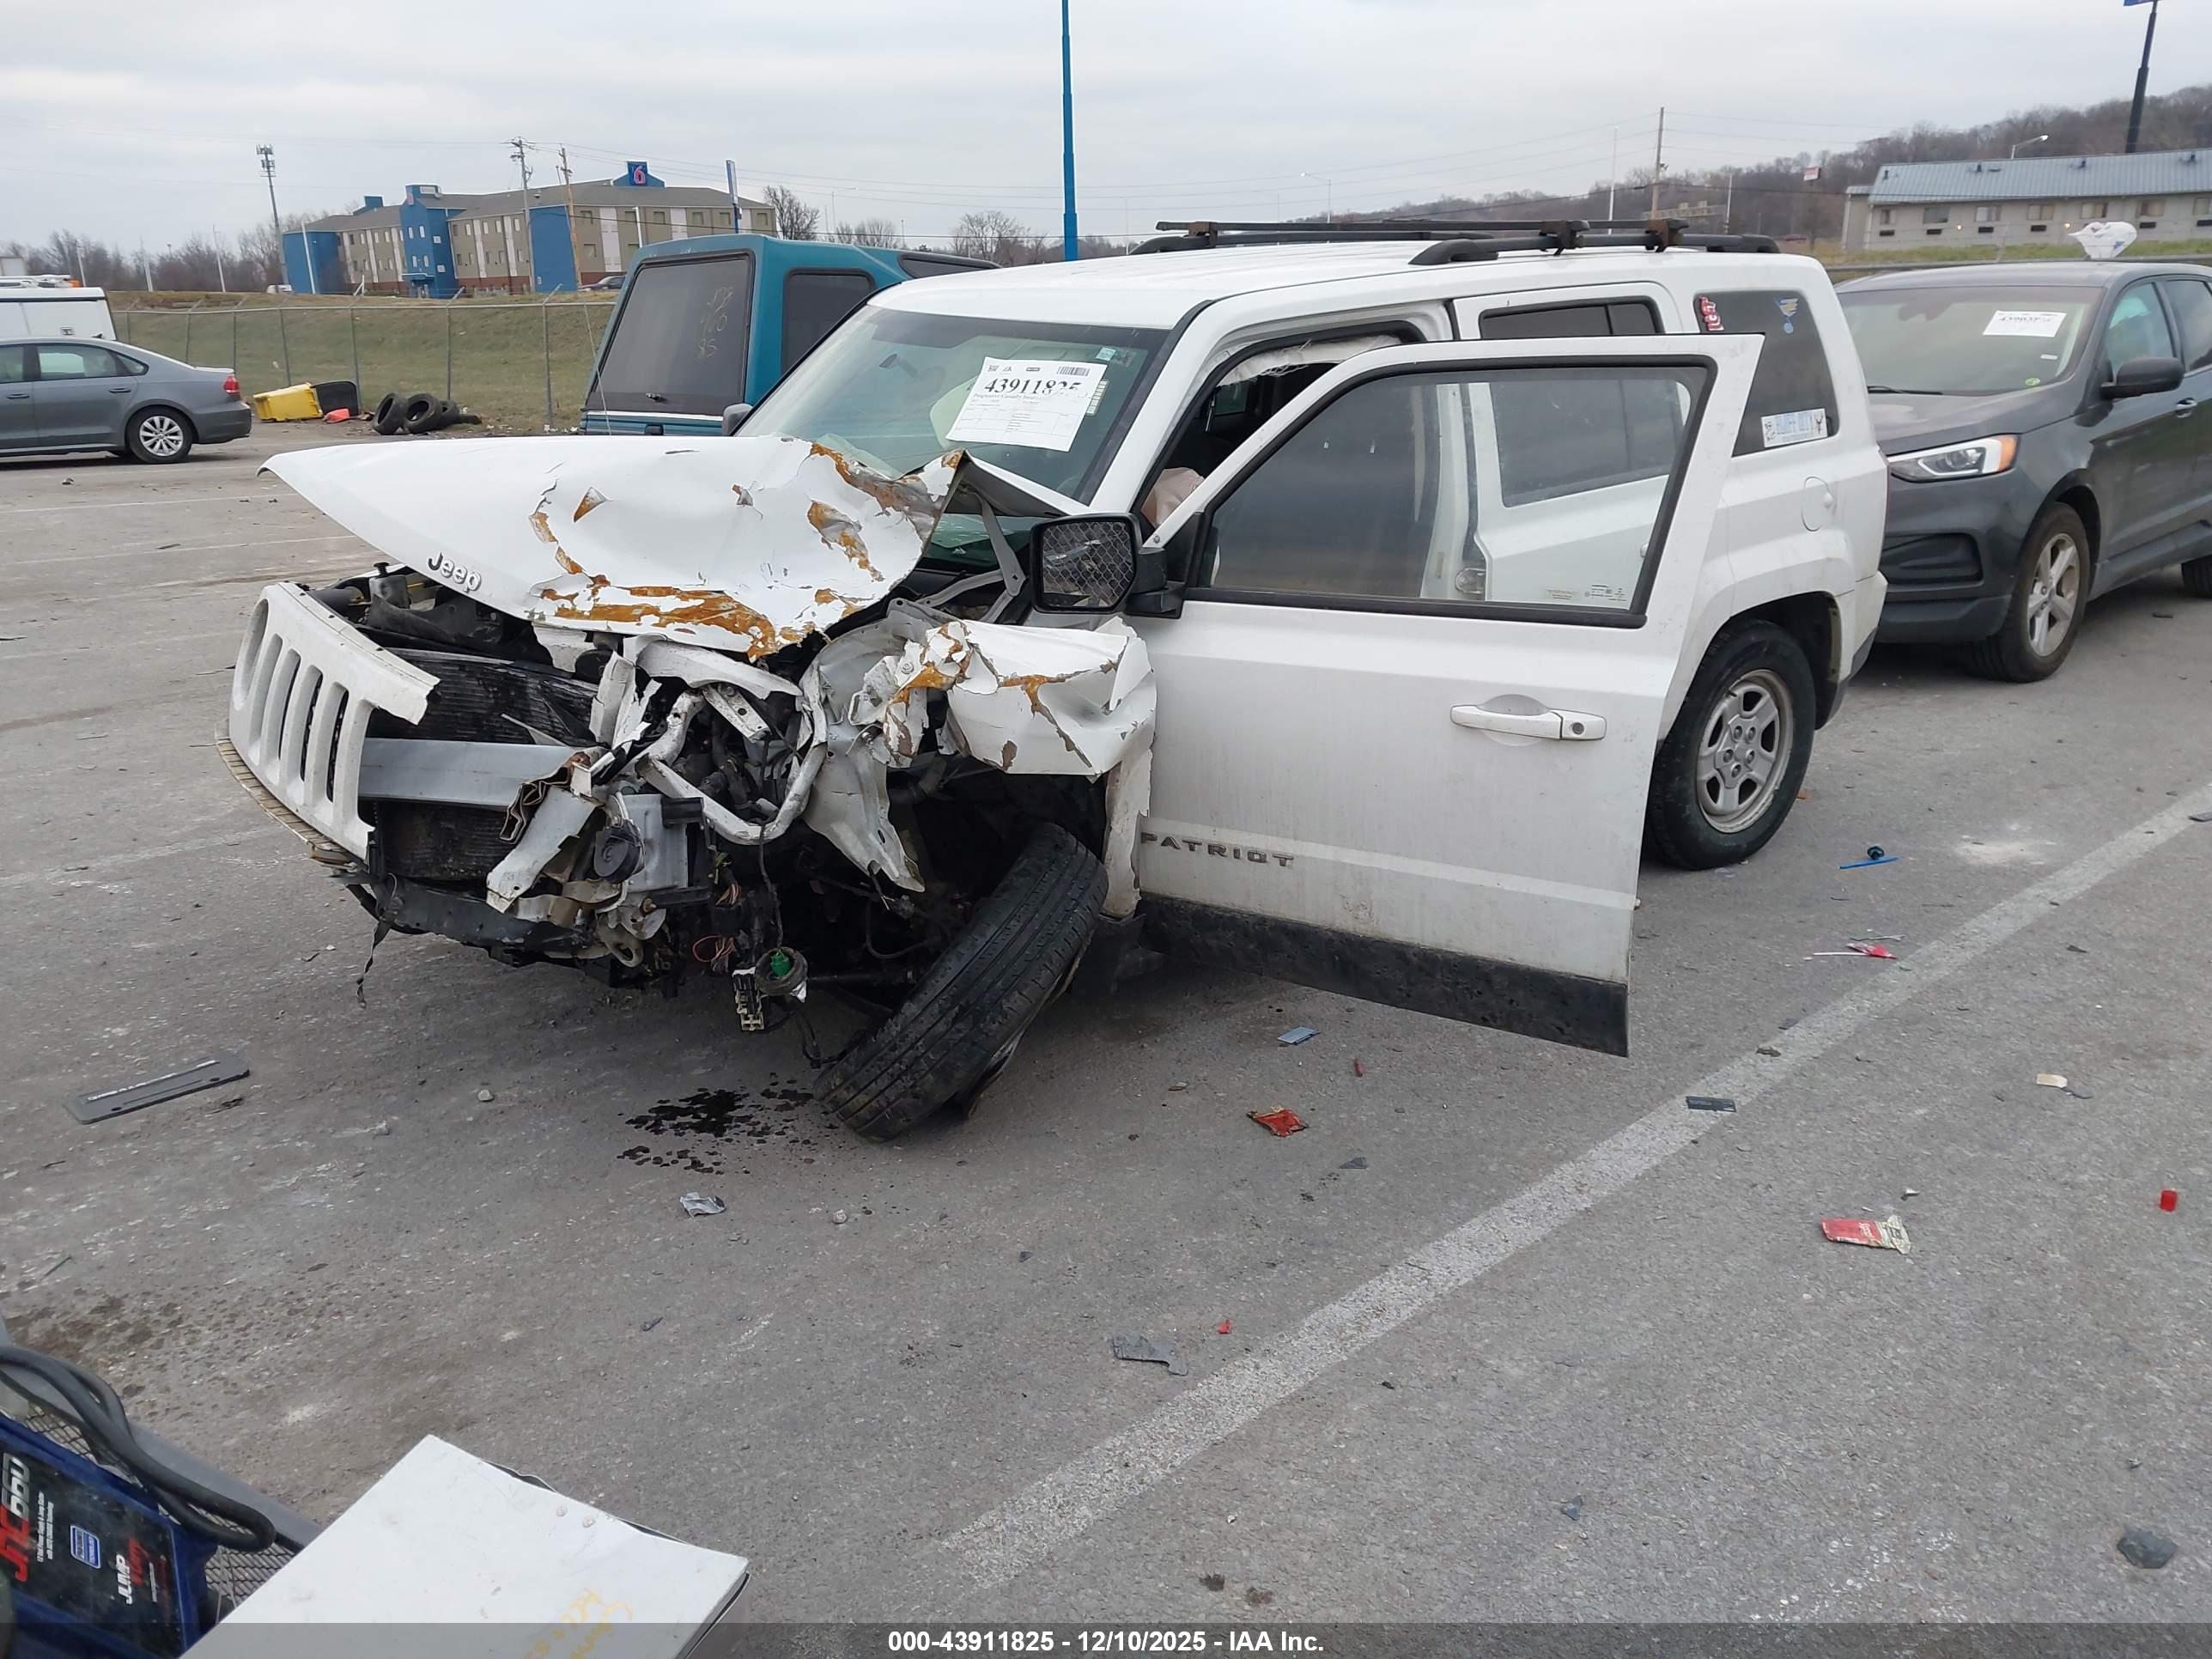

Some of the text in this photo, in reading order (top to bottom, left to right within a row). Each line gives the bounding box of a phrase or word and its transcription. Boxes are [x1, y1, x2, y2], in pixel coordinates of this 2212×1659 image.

[634, 166, 646, 185] 6
[427, 551, 482, 594] Jeep
[1140, 831, 1295, 867] PATRIOT
[116, 1553, 132, 1605] JUMP
